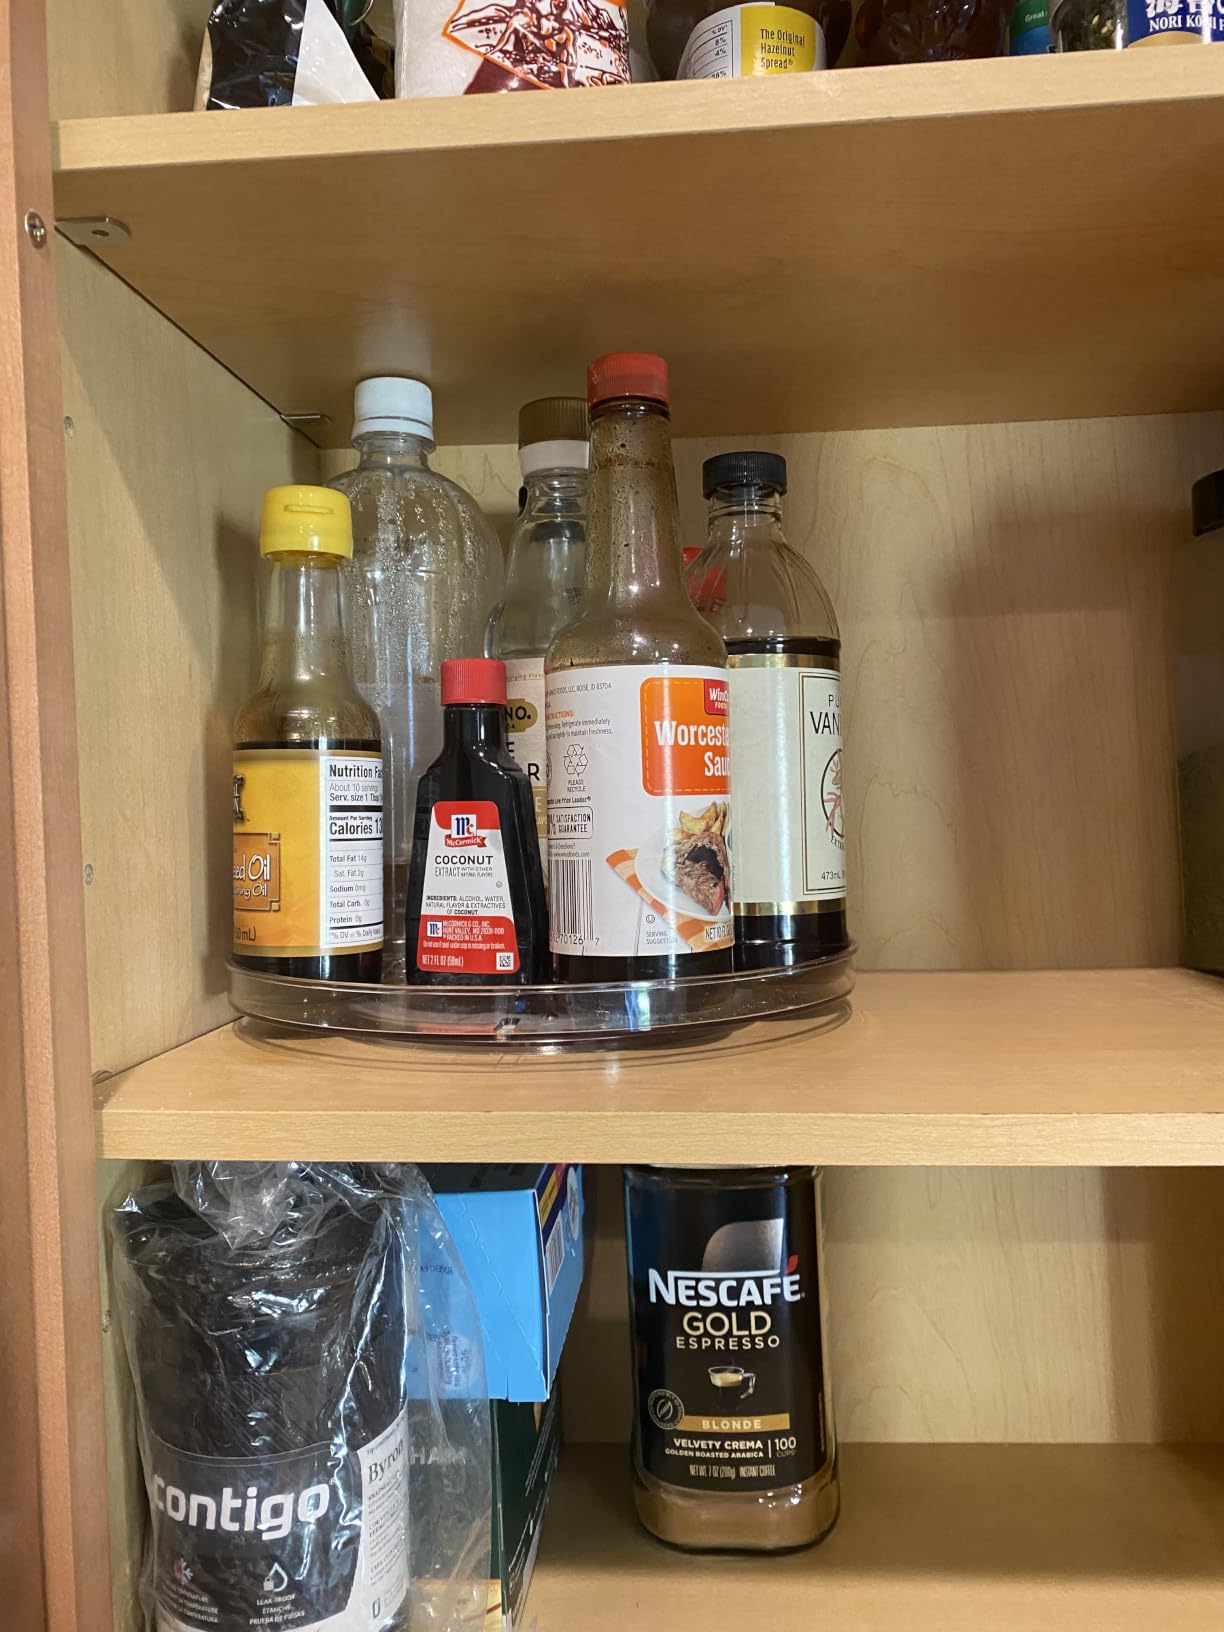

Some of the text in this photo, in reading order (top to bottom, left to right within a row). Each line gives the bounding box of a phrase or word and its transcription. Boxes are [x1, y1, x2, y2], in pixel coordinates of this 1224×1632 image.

[1150, 15, 1182, 32] NORI
[760, 29, 805, 48] The Original
[760, 43, 795, 56] Hazelnut
[329, 764, 373, 778] Nutrition
[330, 782, 351, 792] About
[353, 784, 360, 792] 10
[330, 792, 349, 802] Serv.
[350, 793, 364, 802] size
[556, 813, 591, 823] SATISFACTION
[330, 822, 373, 835] Calories
[558, 824, 588, 833] GUARANTEE
[434, 856, 494, 865] COCONUT
[248, 854, 270, 881] Oil
[434, 866, 460, 877] EXTRACT
[252, 883, 268, 896] Oil
[329, 916, 352, 924] Protein
[706, 926, 715, 940] NET
[682, 1311, 772, 1336] GOLD
[676, 1335, 780, 1350] ESPRESSO
[702, 1419, 762, 1430] BLONDE
[673, 1436, 796, 1450] VELVETY CREMA 100
[665, 1448, 694, 1457] GOLDEN
[696, 1450, 729, 1458] ROASTED
[730, 1450, 764, 1458] ARABICA
